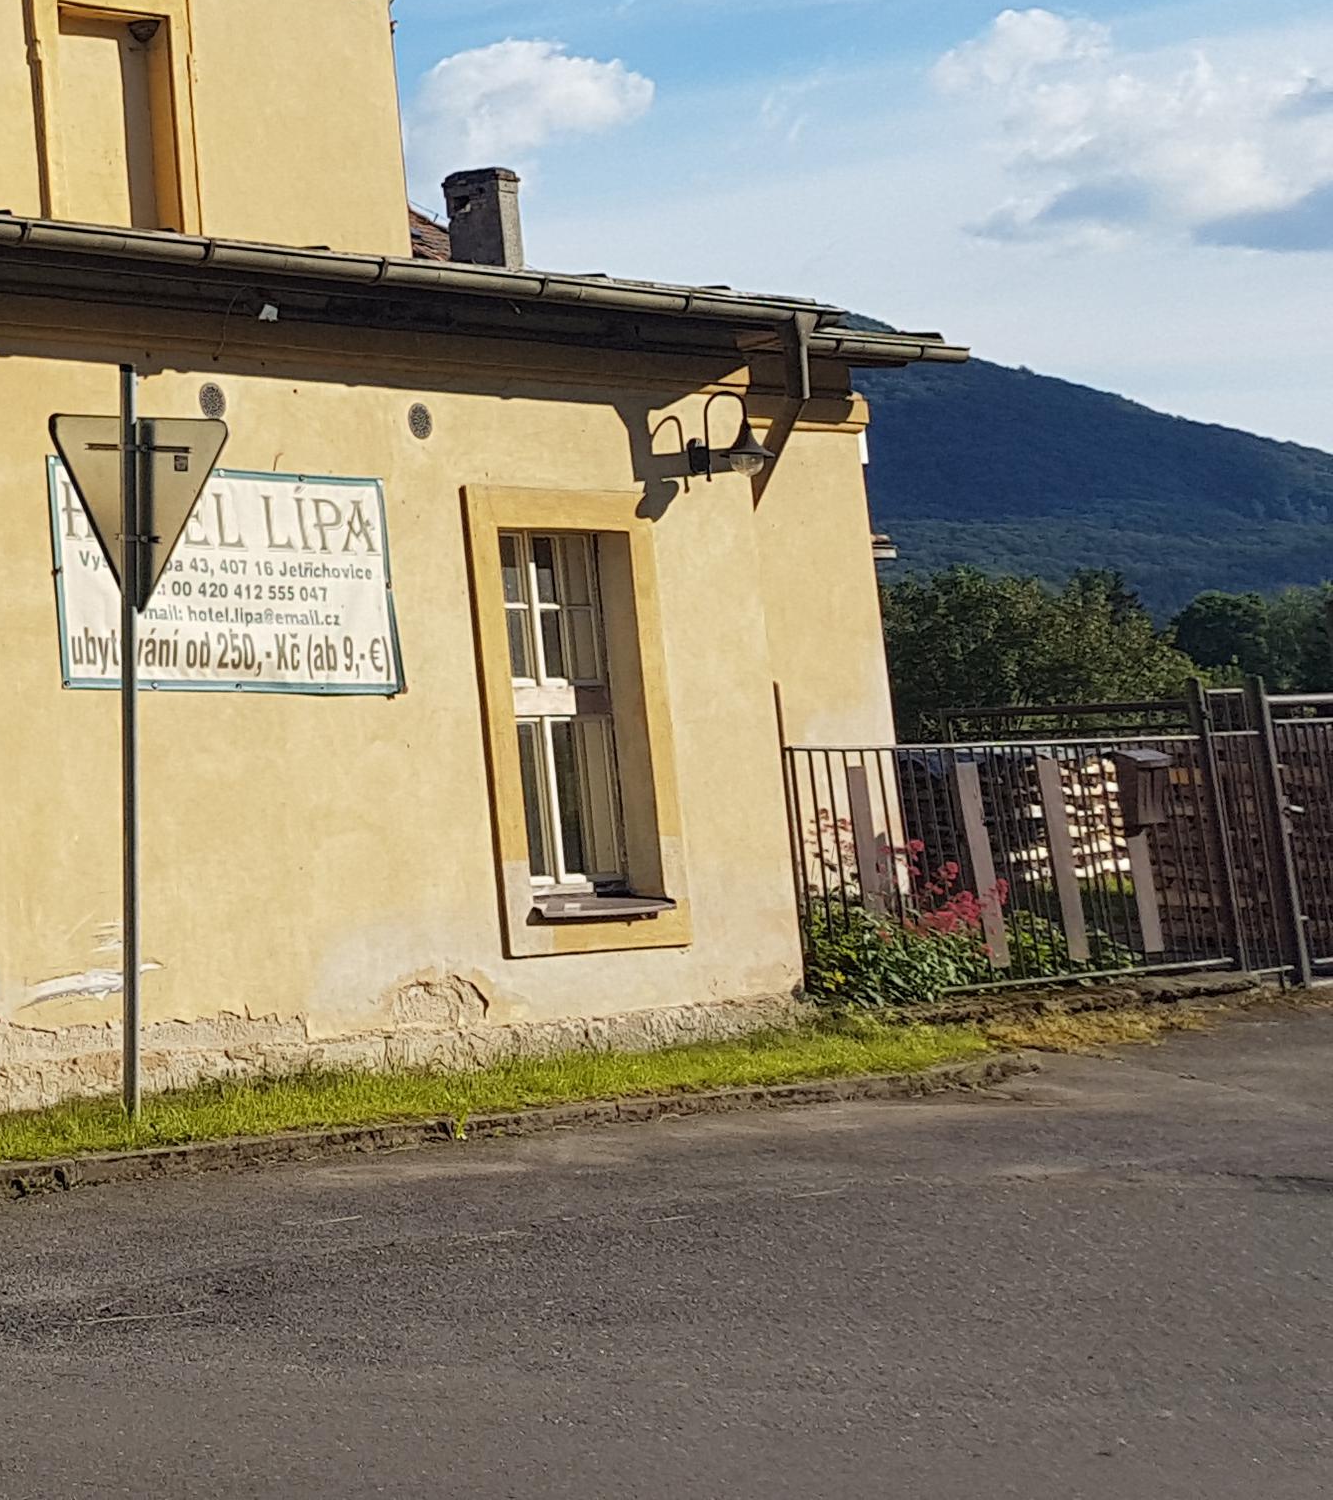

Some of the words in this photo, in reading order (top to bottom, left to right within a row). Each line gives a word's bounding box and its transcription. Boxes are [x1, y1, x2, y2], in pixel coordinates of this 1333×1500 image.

[262, 486, 378, 554] LÍPA
[189, 557, 215, 578] 43,
[219, 559, 248, 576] 407
[255, 560, 274, 577] 16
[279, 561, 373, 581] Jetřichovice
[171, 580, 193, 597] 00
[198, 581, 229, 599] 420
[234, 583, 263, 600] 412
[268, 585, 295, 601] 555
[299, 586, 328, 602] 047
[186, 631, 211, 669] od
[274, 632, 301, 671] Kč
[307, 633, 338, 680] (ab
